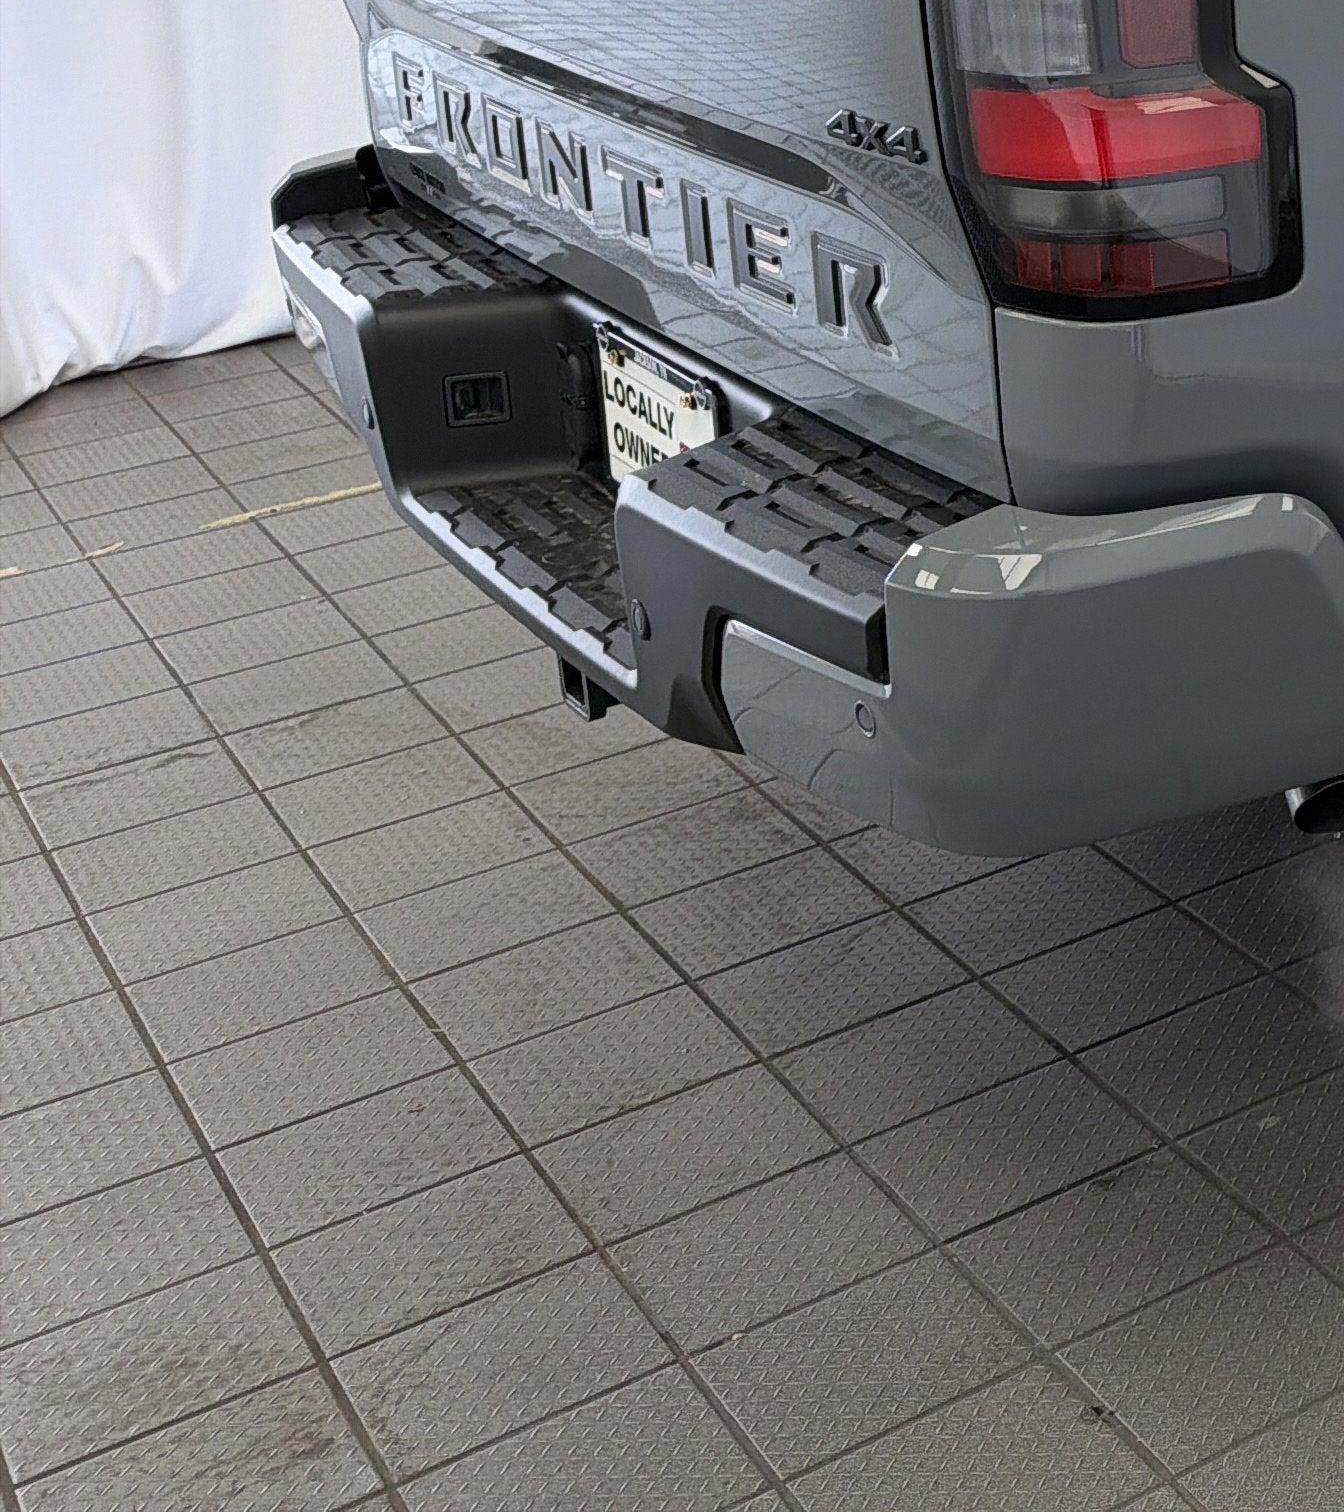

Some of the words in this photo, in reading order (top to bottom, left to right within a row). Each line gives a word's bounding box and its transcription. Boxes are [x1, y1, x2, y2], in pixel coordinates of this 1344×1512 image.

[392, 51, 899, 360] FRONTIER
[603, 369, 675, 441] LOCALLY
[613, 421, 669, 467] OWNE
